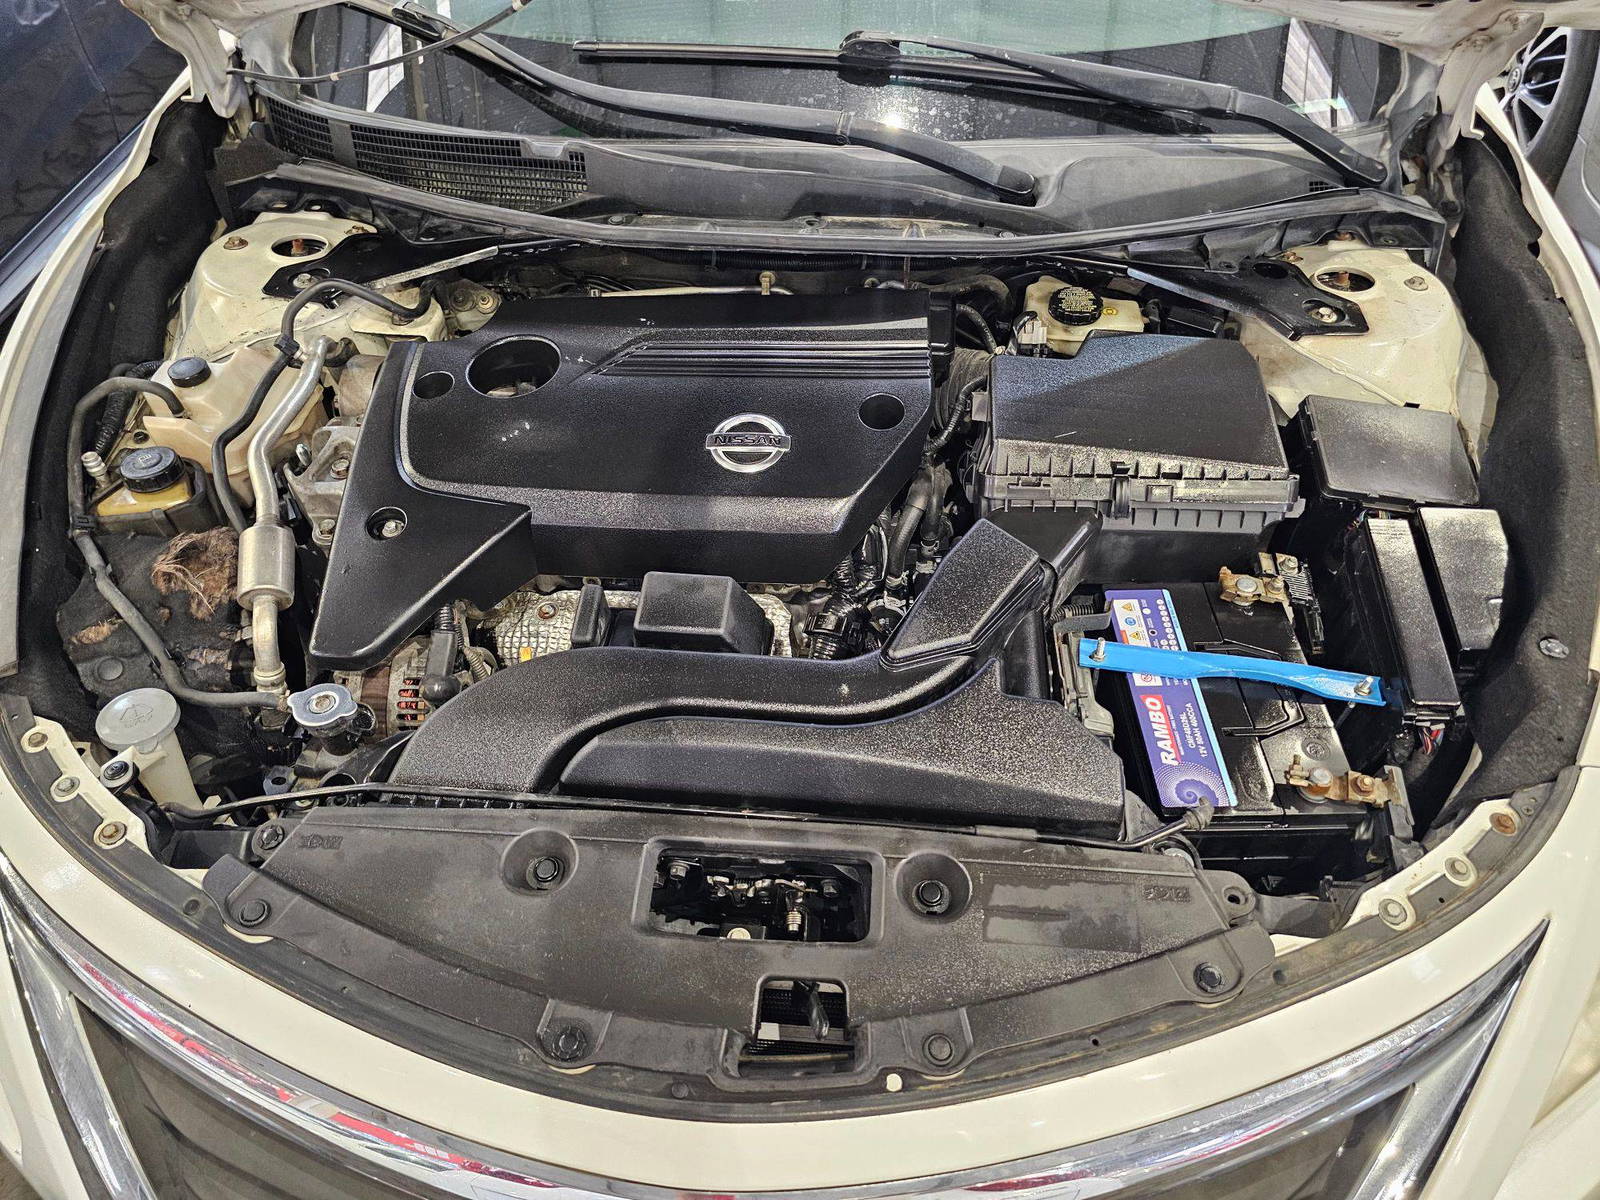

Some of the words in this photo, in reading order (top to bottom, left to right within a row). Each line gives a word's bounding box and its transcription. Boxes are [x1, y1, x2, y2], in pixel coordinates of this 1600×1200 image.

[714, 436, 782, 447] NISSAN
[1145, 697, 1180, 766] RAMBO
[1198, 745, 1208, 758] 12V
